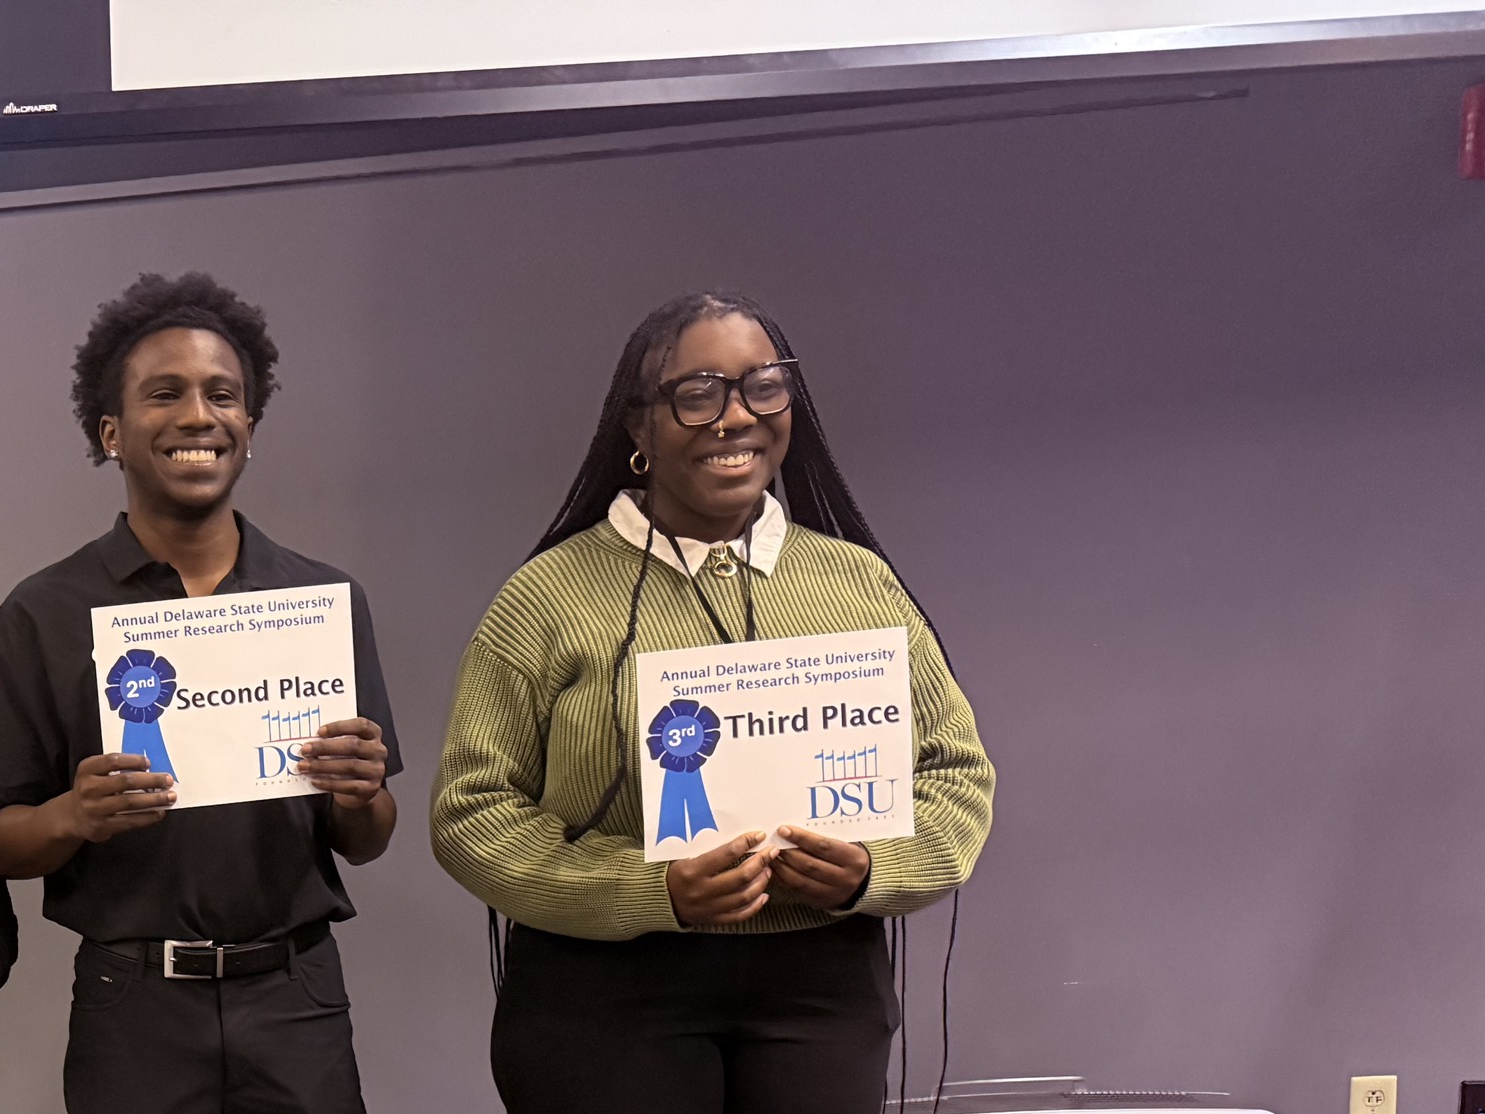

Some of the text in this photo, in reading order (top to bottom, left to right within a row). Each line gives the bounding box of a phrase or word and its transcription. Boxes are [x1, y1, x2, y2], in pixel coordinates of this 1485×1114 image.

[21, 104, 57, 113] DRAPER
[112, 596, 334, 628] Annual Delaware State University
[124, 613, 324, 643] Summer Research Symposium
[661, 649, 895, 682] Annual Delaware State University
[126, 676, 155, 698] 2nd
[177, 676, 344, 710] Second Place
[673, 667, 884, 697] Summer Research Symposium
[668, 724, 696, 747] 3rd
[723, 703, 899, 738] Third Place
[254, 743, 305, 779] DS
[805, 778, 899, 820] DSU
